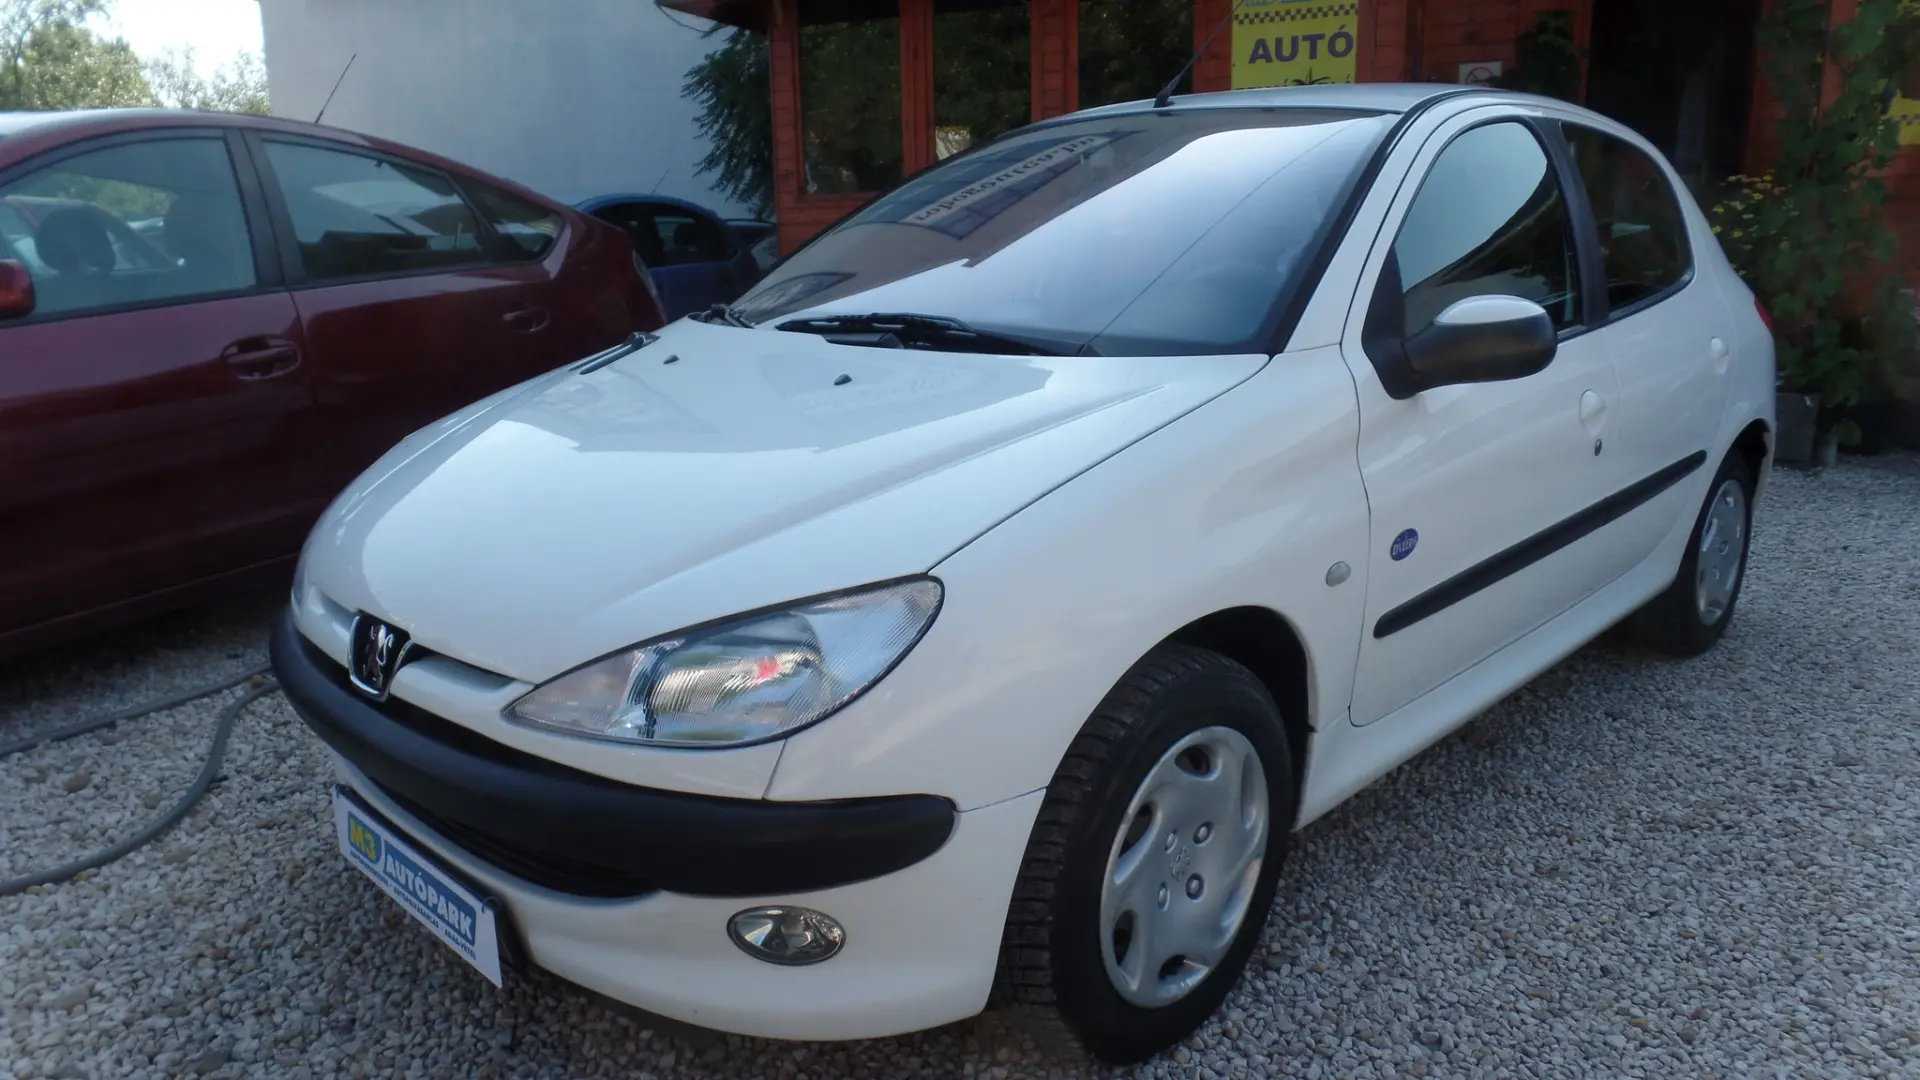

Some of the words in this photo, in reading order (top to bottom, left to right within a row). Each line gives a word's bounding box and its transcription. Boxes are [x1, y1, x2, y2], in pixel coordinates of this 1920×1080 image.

[1248, 24, 1354, 64] AUTÓ
[349, 817, 377, 861] M3
[386, 853, 473, 941] AUTÓPARK
